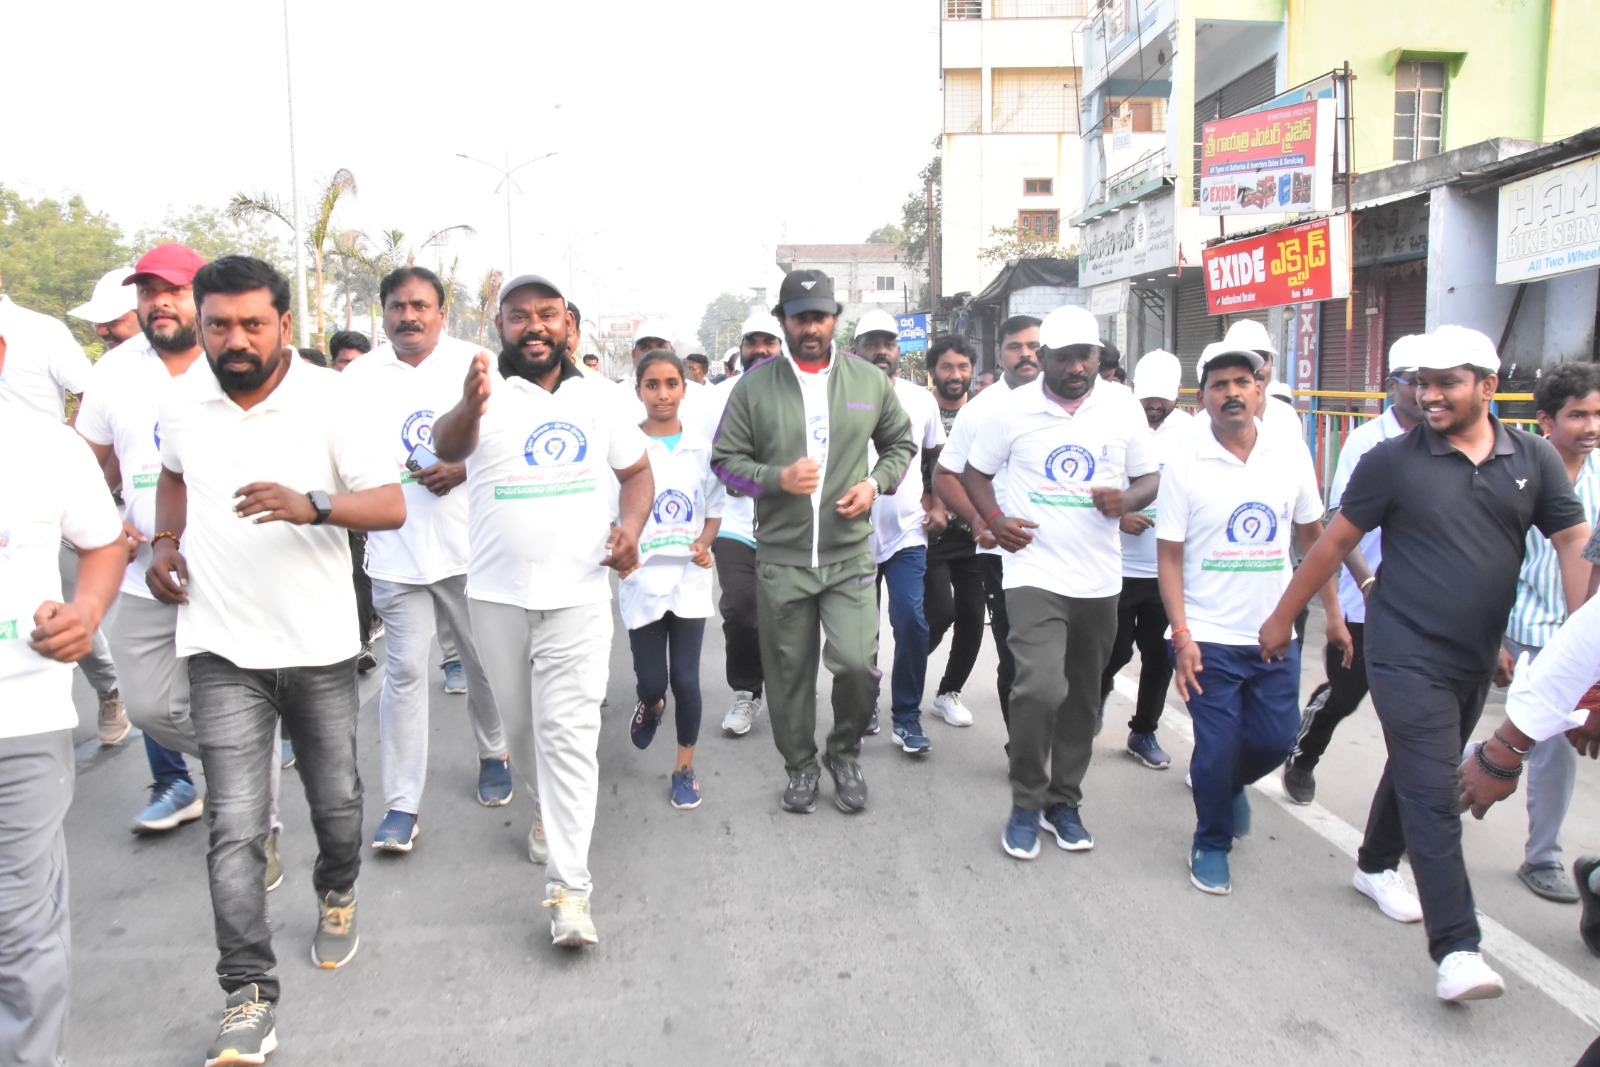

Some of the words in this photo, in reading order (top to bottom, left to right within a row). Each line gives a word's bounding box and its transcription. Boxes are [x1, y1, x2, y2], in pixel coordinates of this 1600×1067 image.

[1215, 165, 1225, 174] Types
[1229, 162, 1246, 171] Batteries
[1250, 160, 1268, 169] Inverters
[1267, 158, 1279, 167] Sales
[1279, 157, 1283, 166] &
[1283, 155, 1304, 166] Servicing
[1210, 184, 1236, 202] EXIDE
[1506, 226, 1548, 260] BIKE
[1208, 246, 1266, 290] EXIDE
[1527, 259, 1541, 273] All
[1545, 255, 1564, 268] Two
[1241, 291, 1256, 302] Dealer
[1302, 287, 1314, 296] Safar
